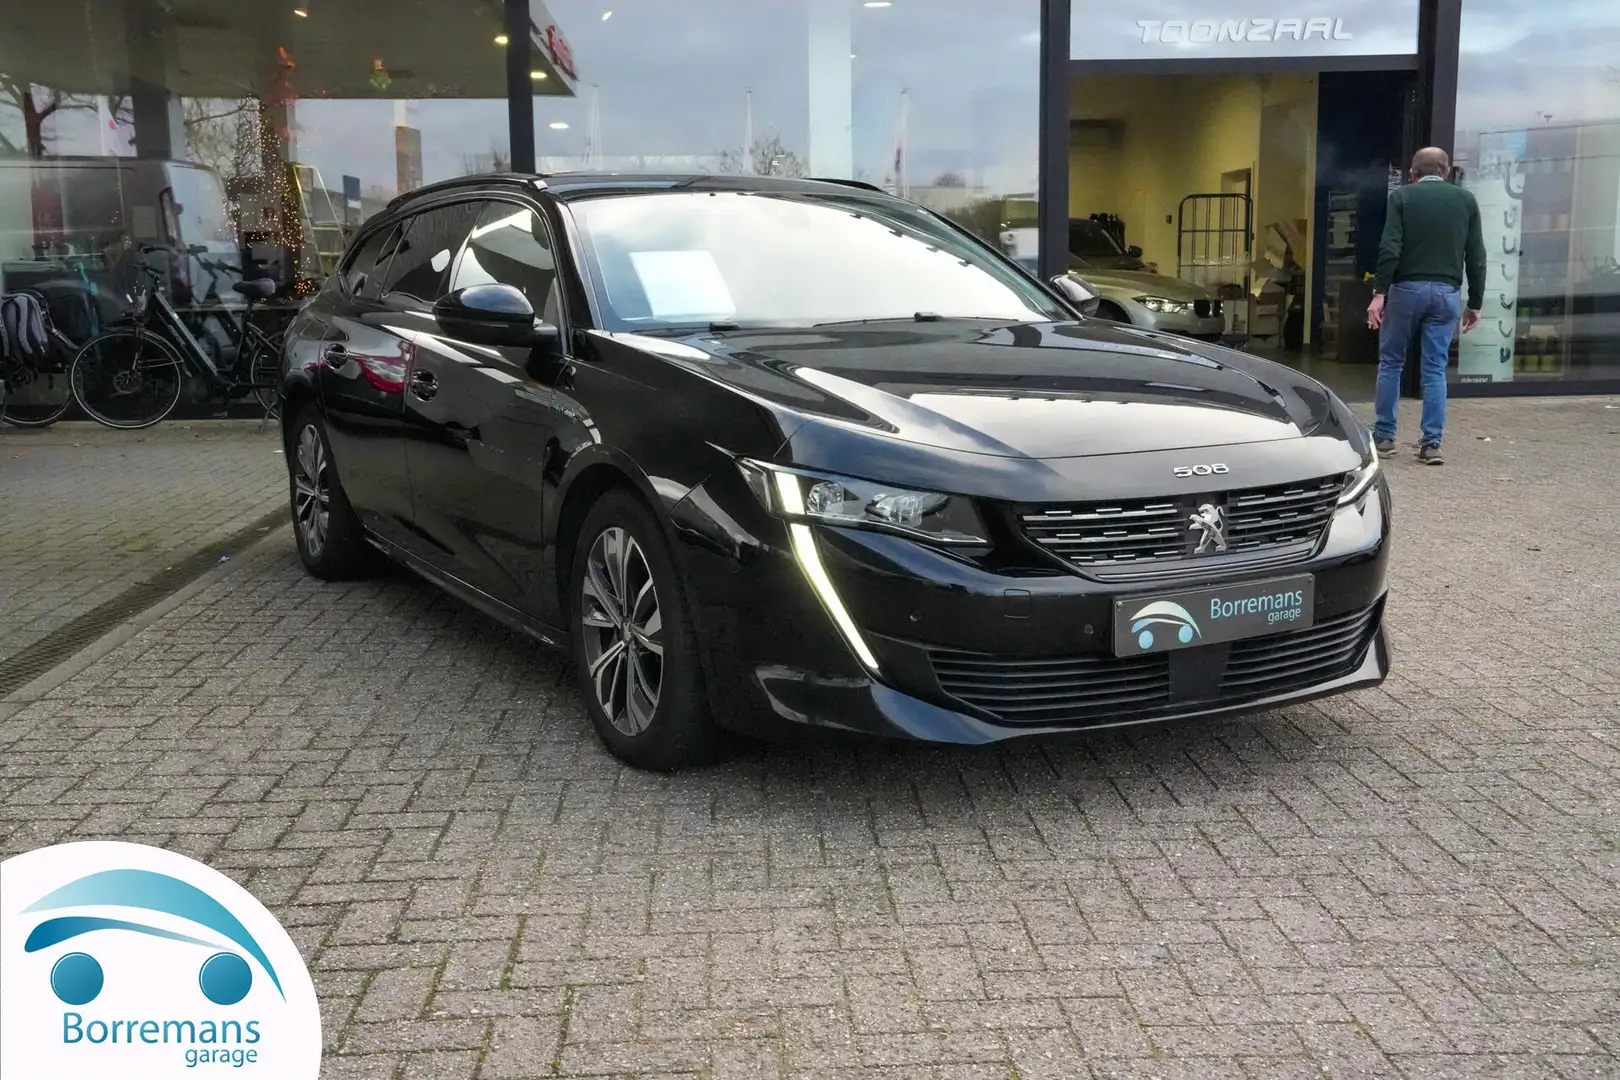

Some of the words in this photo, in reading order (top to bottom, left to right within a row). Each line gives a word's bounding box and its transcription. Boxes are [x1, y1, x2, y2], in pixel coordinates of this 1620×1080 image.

[1136, 17, 1354, 43] TOONZAAL
[1173, 463, 1230, 478] 508
[1210, 590, 1303, 619] Borremans
[1267, 607, 1301, 625] garage
